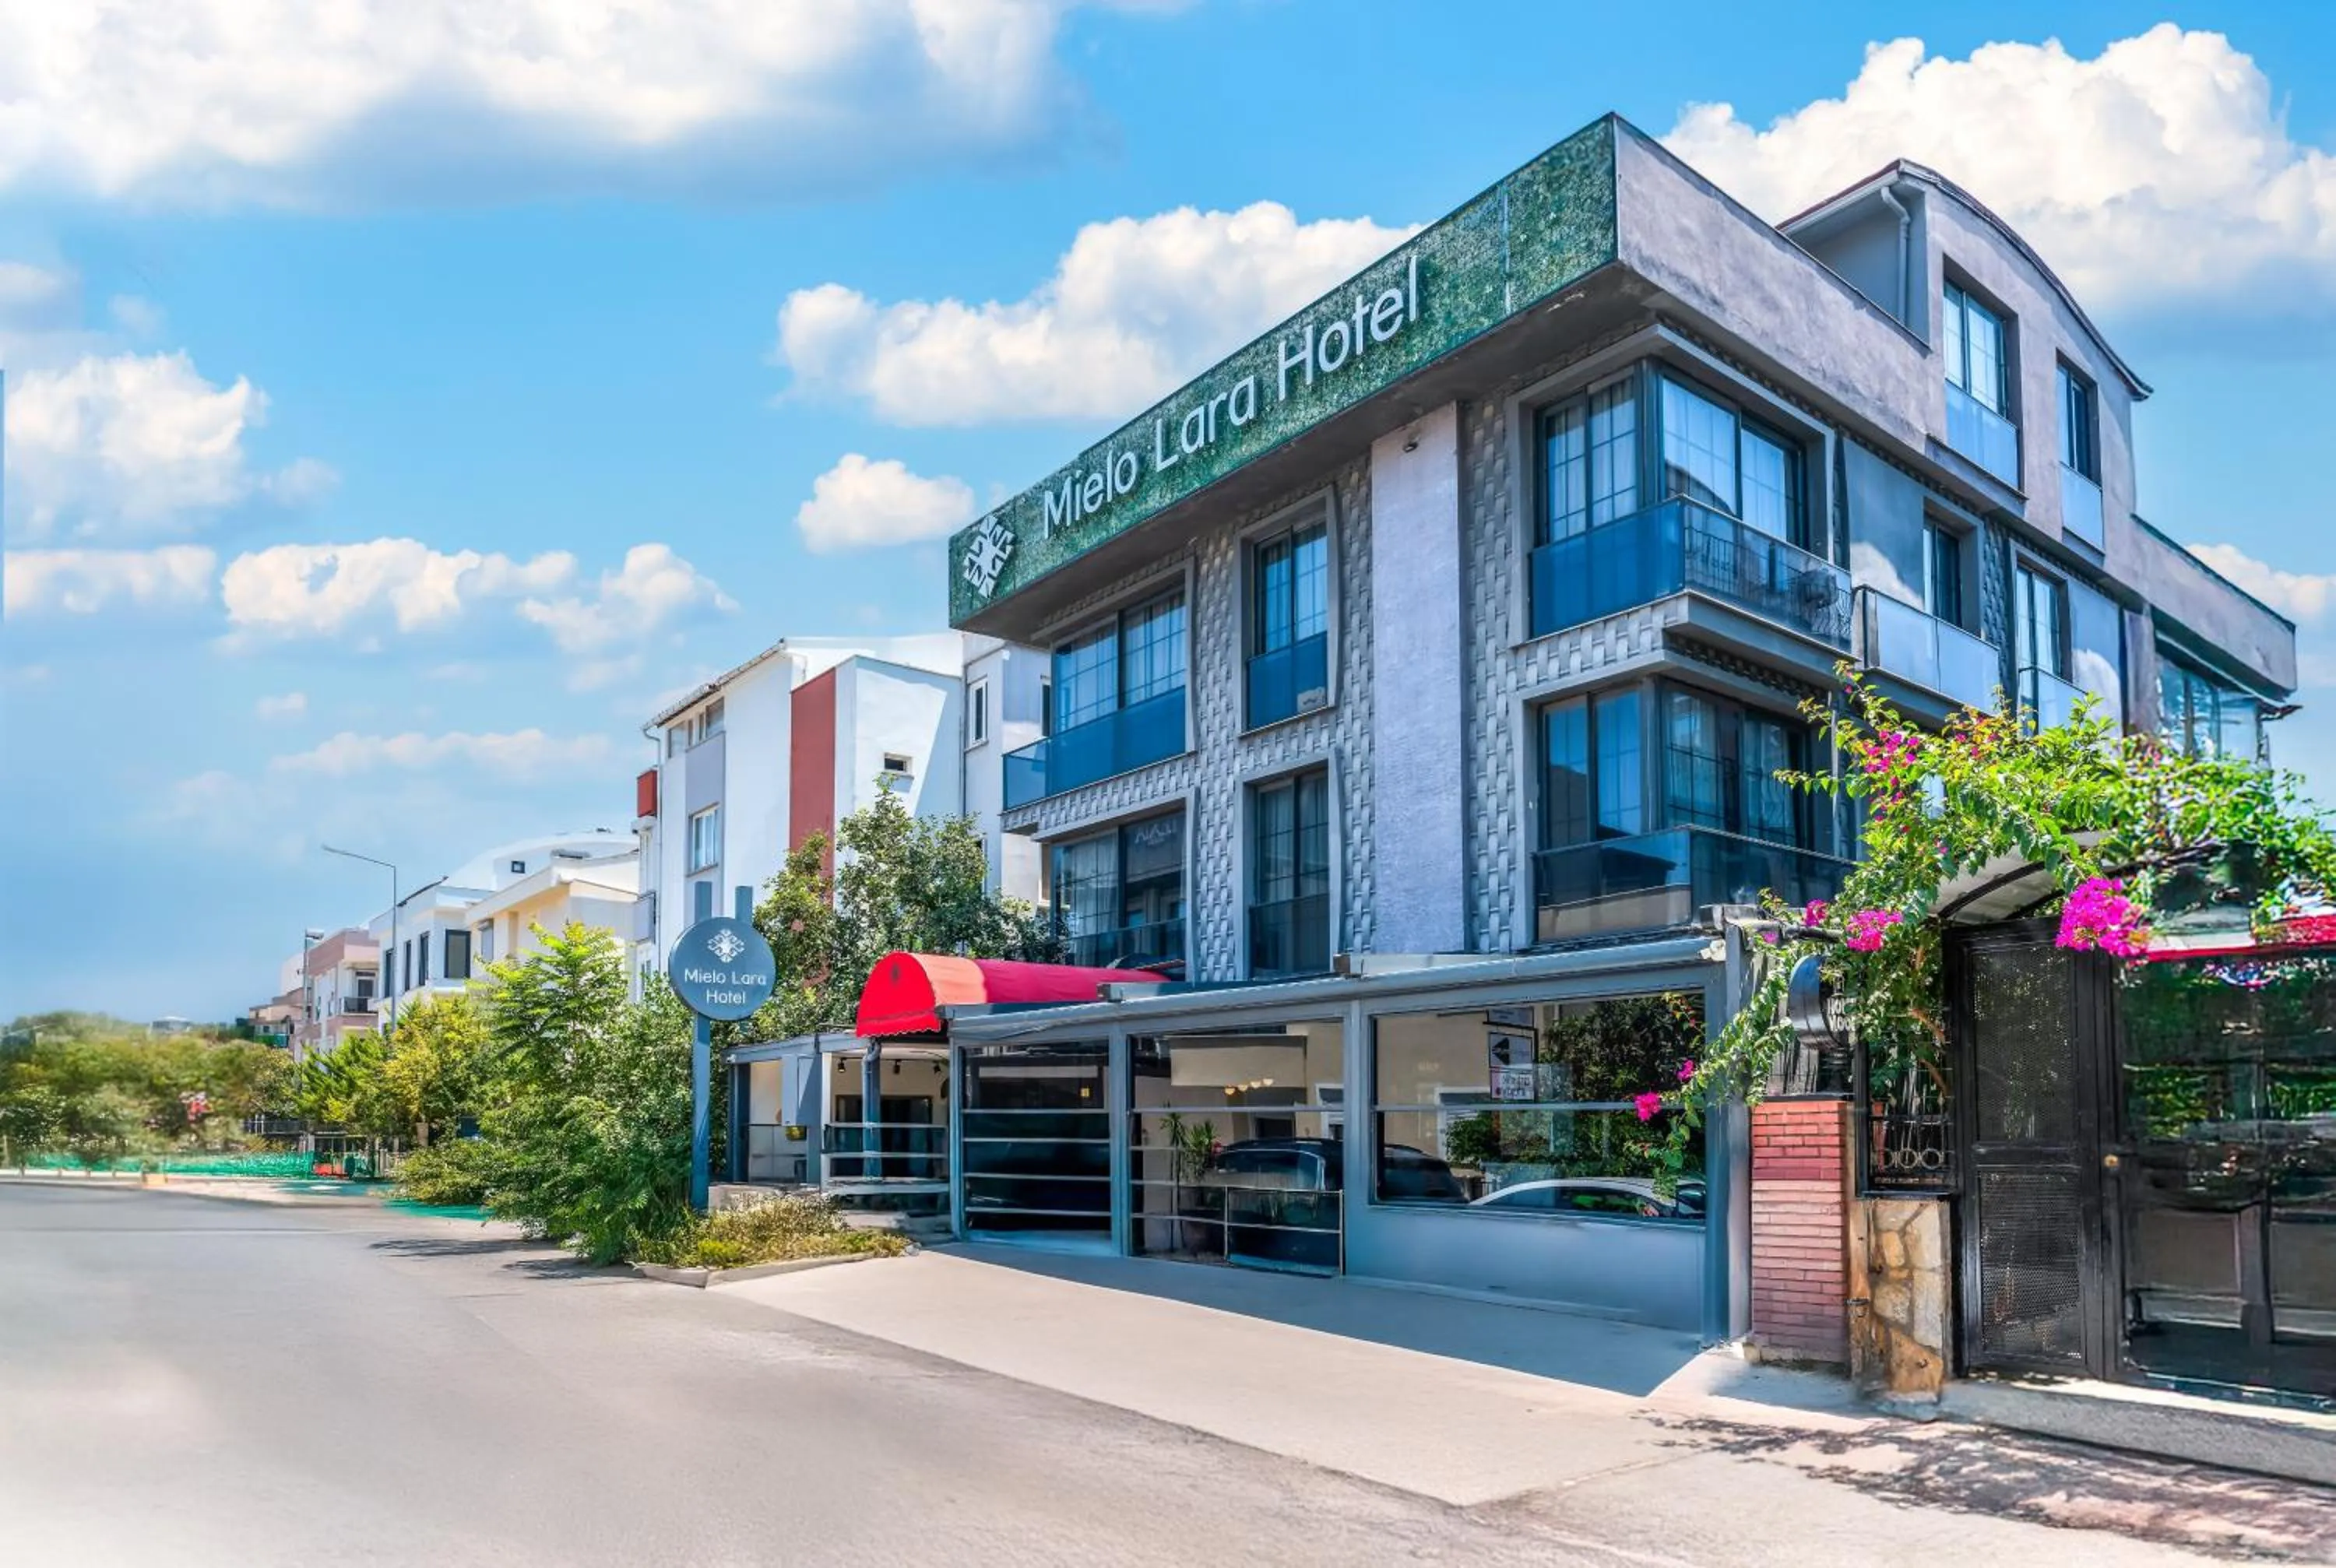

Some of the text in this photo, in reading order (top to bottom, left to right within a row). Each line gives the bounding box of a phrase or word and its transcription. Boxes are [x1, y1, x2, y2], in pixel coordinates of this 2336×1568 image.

[1043, 256, 1419, 540] Mielo Lara Hotel
[684, 968, 767, 985] Mielo Lara
[706, 989, 746, 1004] Hotel
